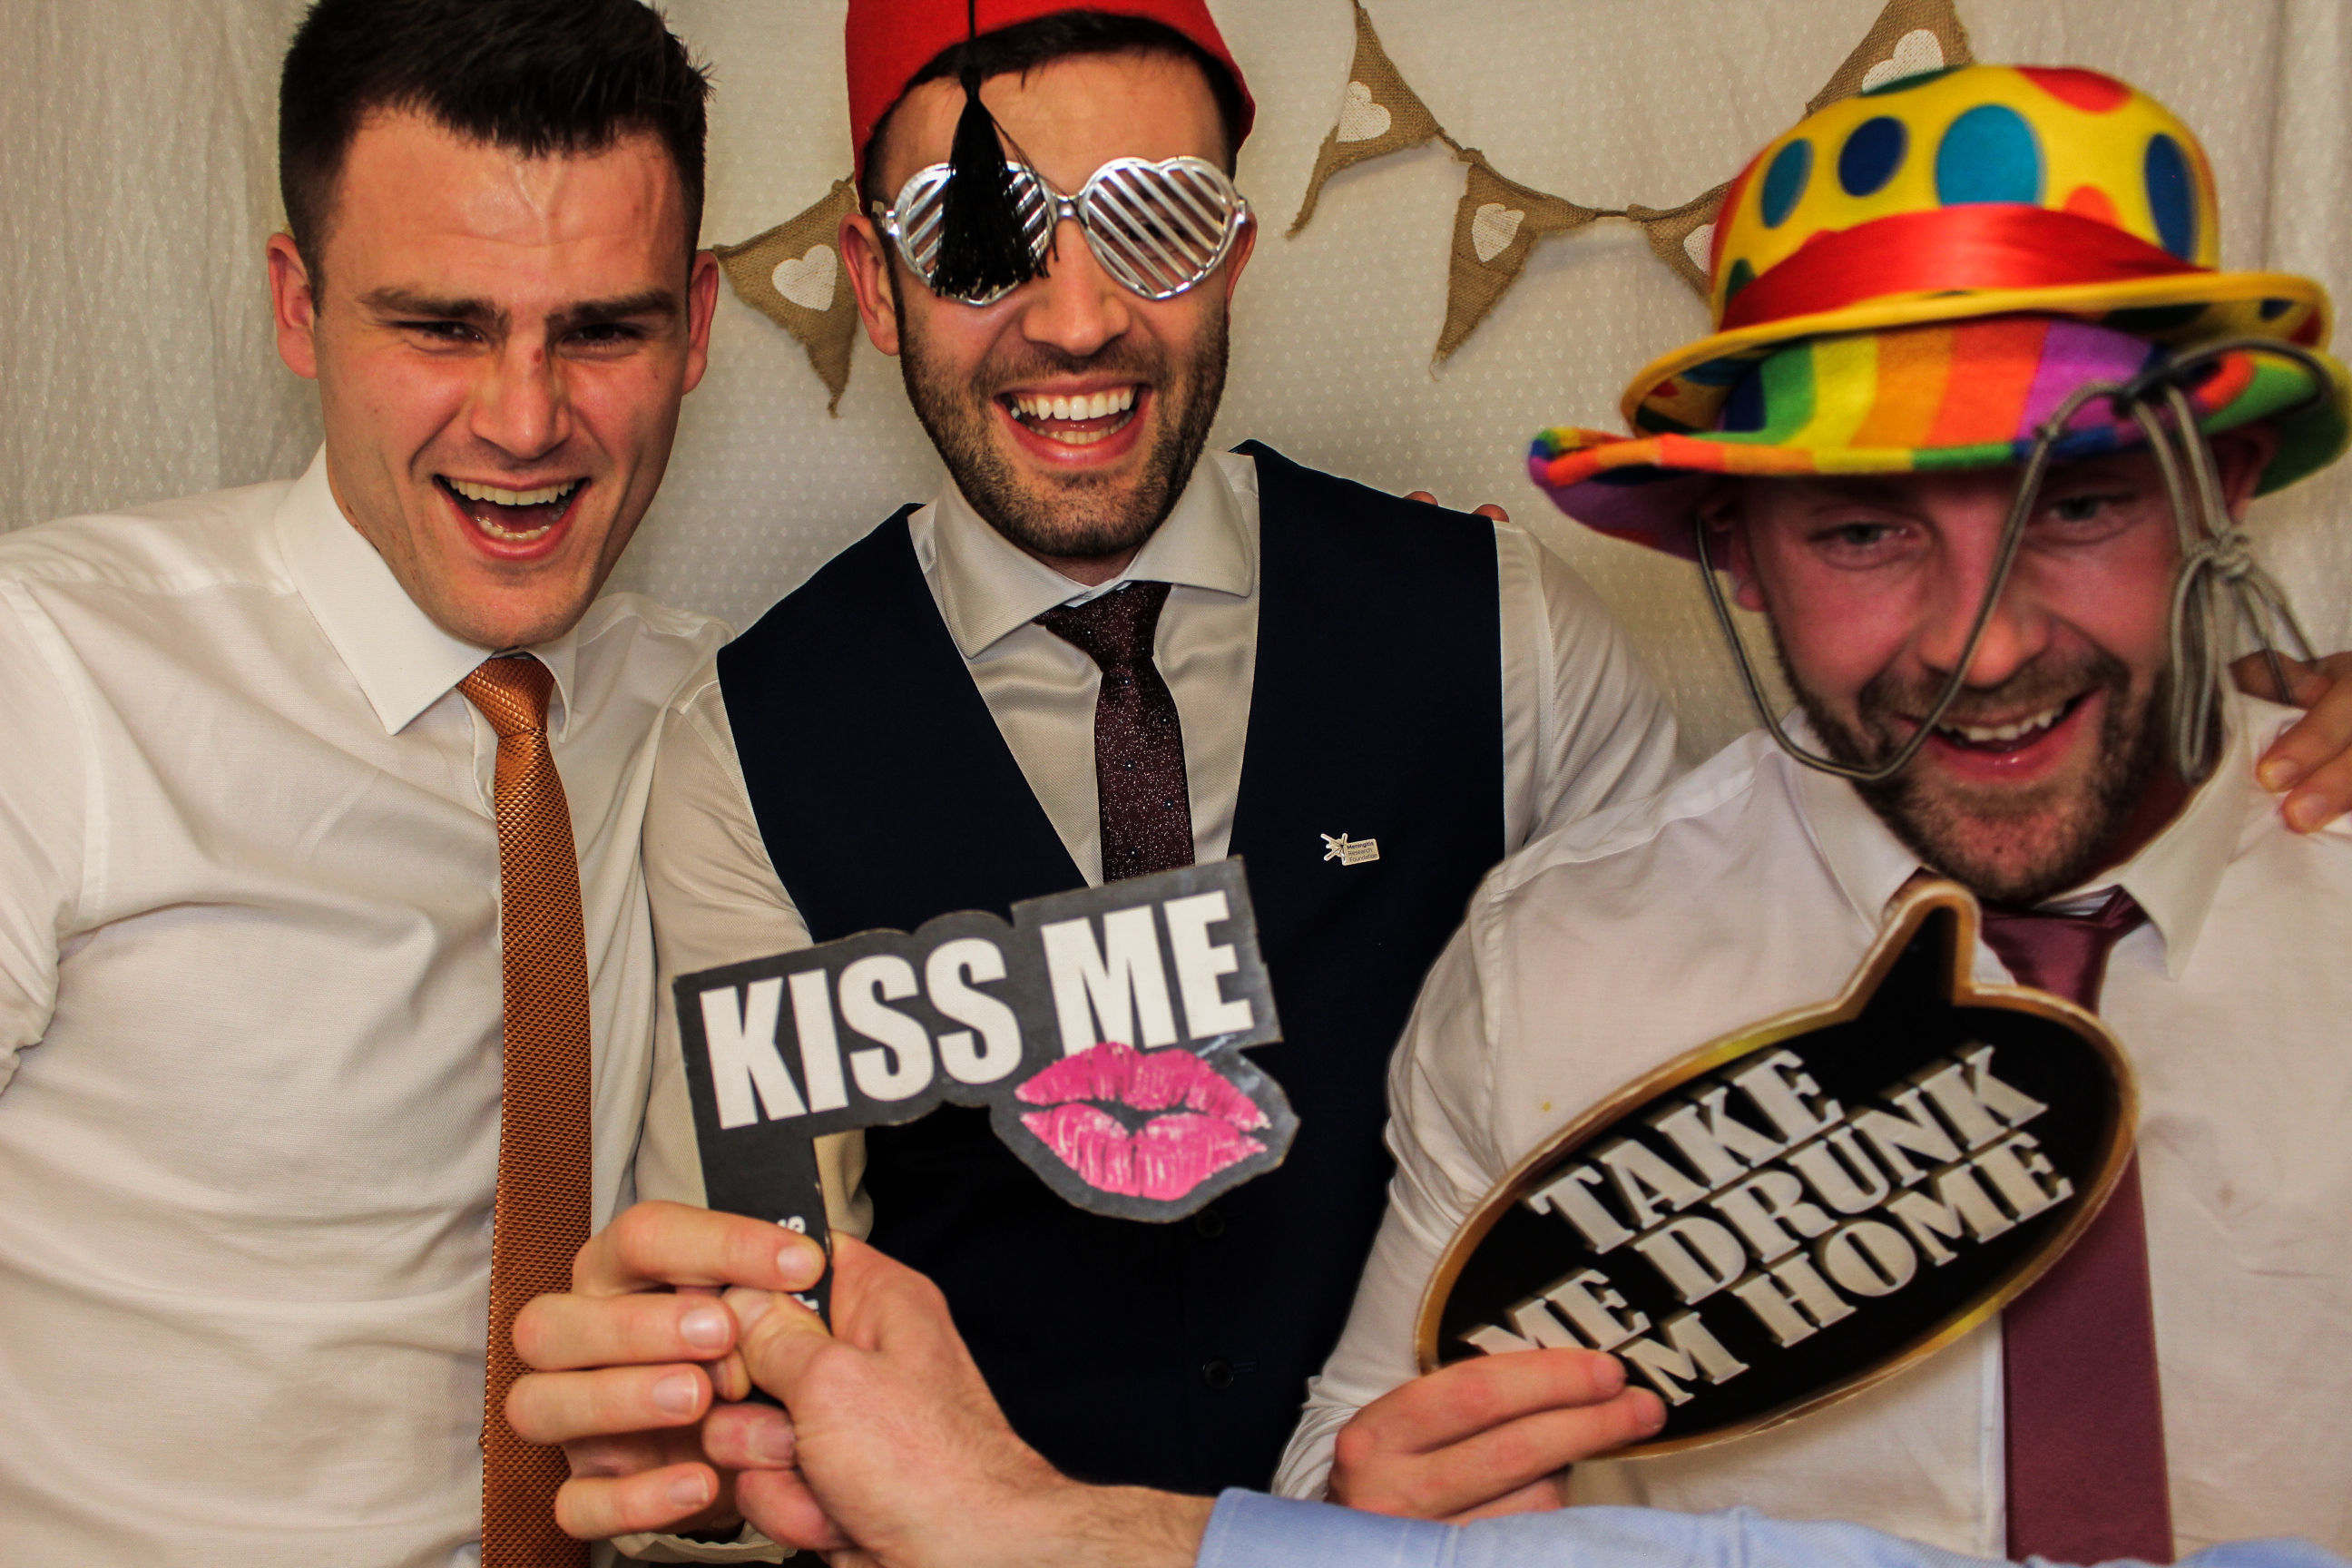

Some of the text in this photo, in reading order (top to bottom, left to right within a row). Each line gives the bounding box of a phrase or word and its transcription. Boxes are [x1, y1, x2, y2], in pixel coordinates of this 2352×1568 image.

[1347, 840, 1375, 850] Meningitis
[1348, 847, 1373, 857] Research
[1349, 853, 1378, 863] Foundation
[700, 890, 1255, 1130] KISS ME
[1529, 1049, 1846, 1255] TAKE
[1632, 1044, 2049, 1307] DRUNK
[1731, 1131, 2075, 1348] HOME
